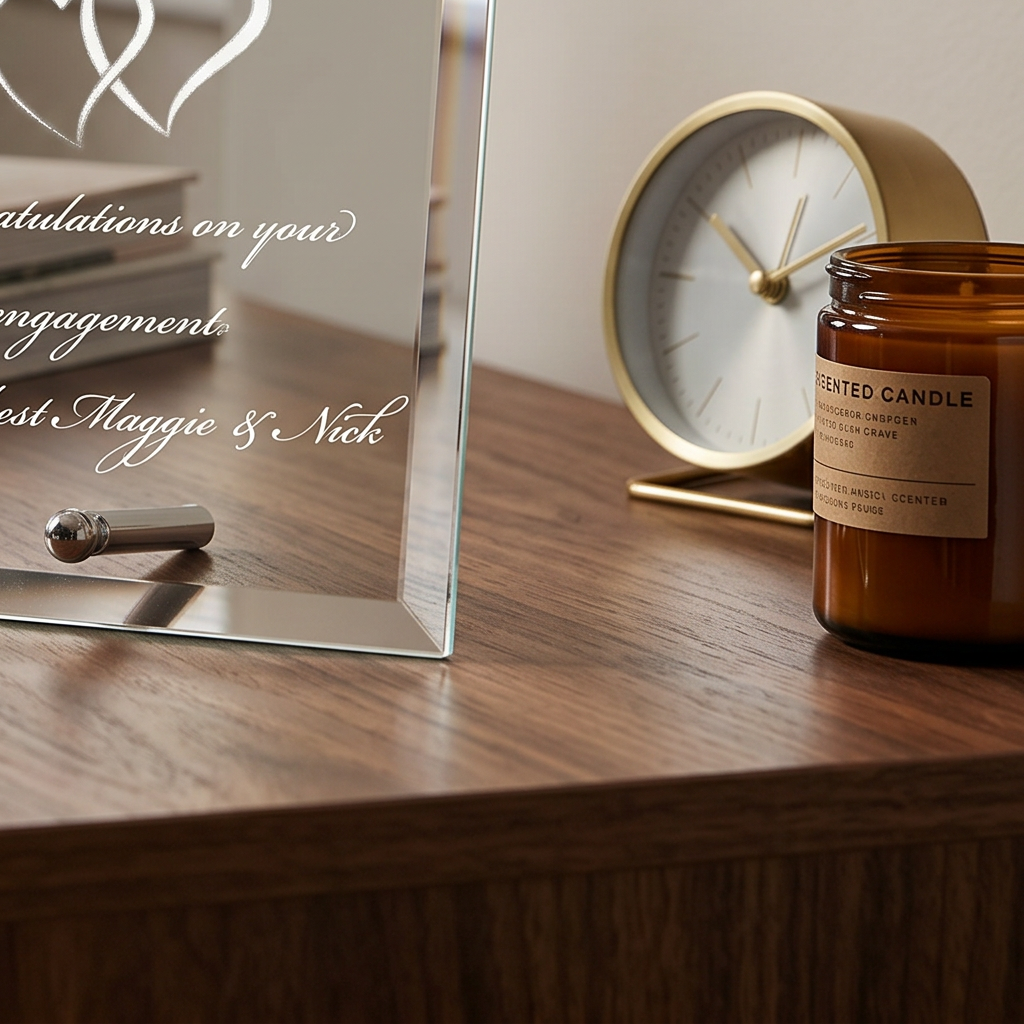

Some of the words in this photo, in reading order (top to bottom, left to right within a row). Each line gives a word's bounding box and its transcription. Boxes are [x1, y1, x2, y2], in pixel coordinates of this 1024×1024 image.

[192, 220, 244, 238] on
[241, 210, 357, 269] your
[881, 387, 973, 407] CANDLE
[51, 393, 218, 474] Maggie
[232, 409, 277, 451] &
[271, 395, 410, 445] Nick
